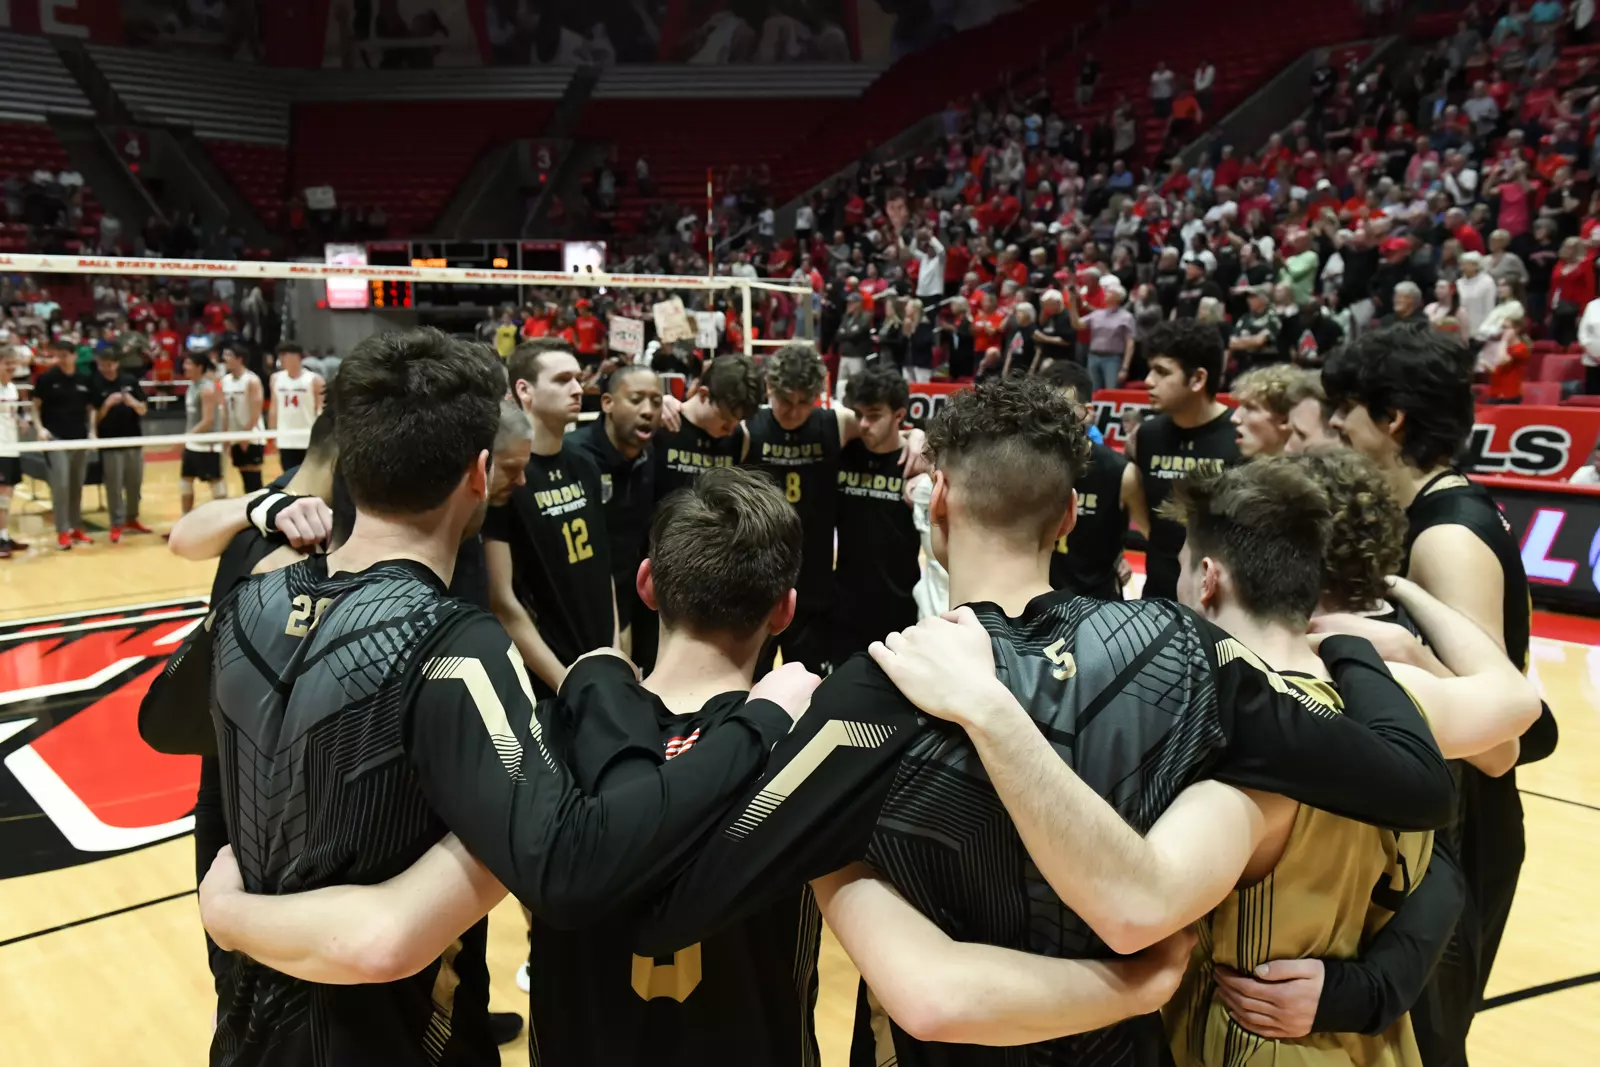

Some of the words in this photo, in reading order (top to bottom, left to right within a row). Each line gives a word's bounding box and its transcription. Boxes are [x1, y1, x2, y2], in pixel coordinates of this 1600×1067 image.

[284, 395, 299, 408] 14
[762, 441, 824, 459] PURDUE
[785, 471, 803, 504] 8
[561, 517, 594, 565] 12
[1042, 637, 1077, 681] 5
